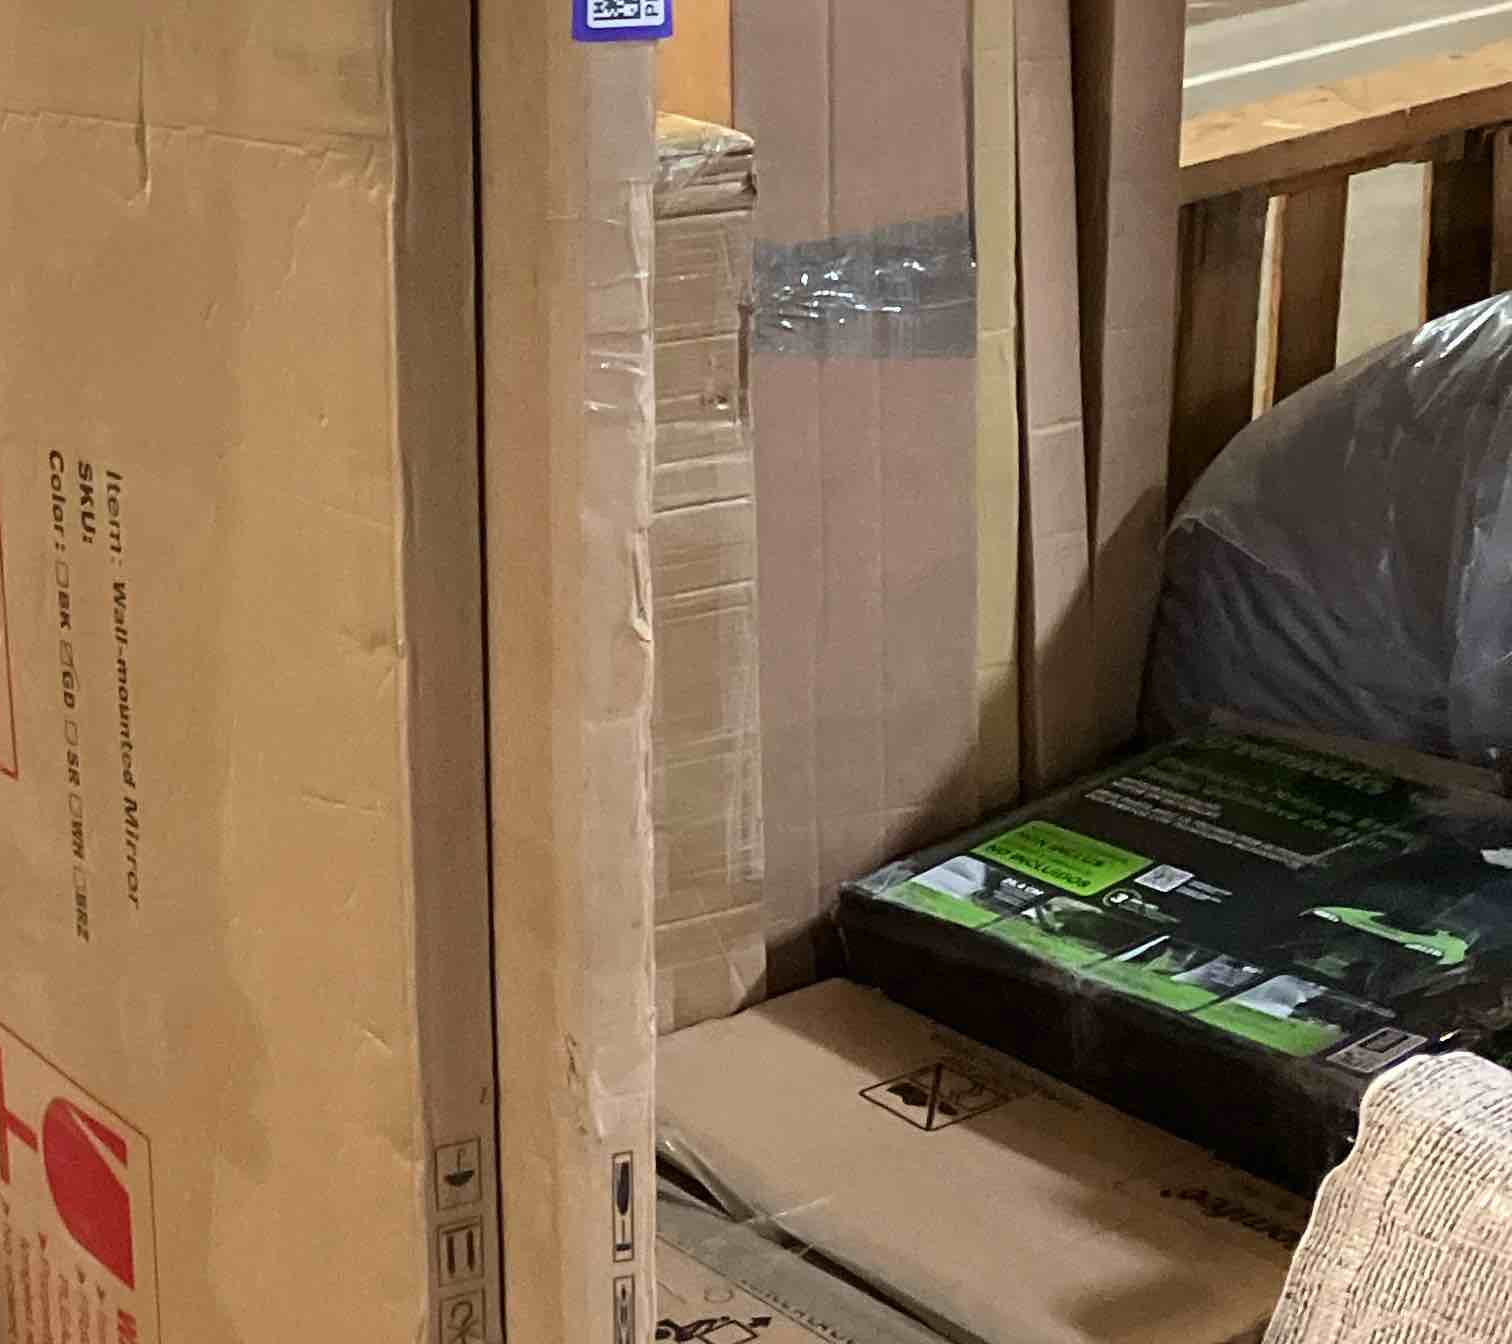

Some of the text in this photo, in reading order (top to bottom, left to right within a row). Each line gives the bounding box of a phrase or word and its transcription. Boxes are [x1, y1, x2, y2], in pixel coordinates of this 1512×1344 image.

[77, 459, 97, 545] SKU:
[112, 581, 137, 790] Wall-mounted
[122, 796, 139, 911] Mirror
